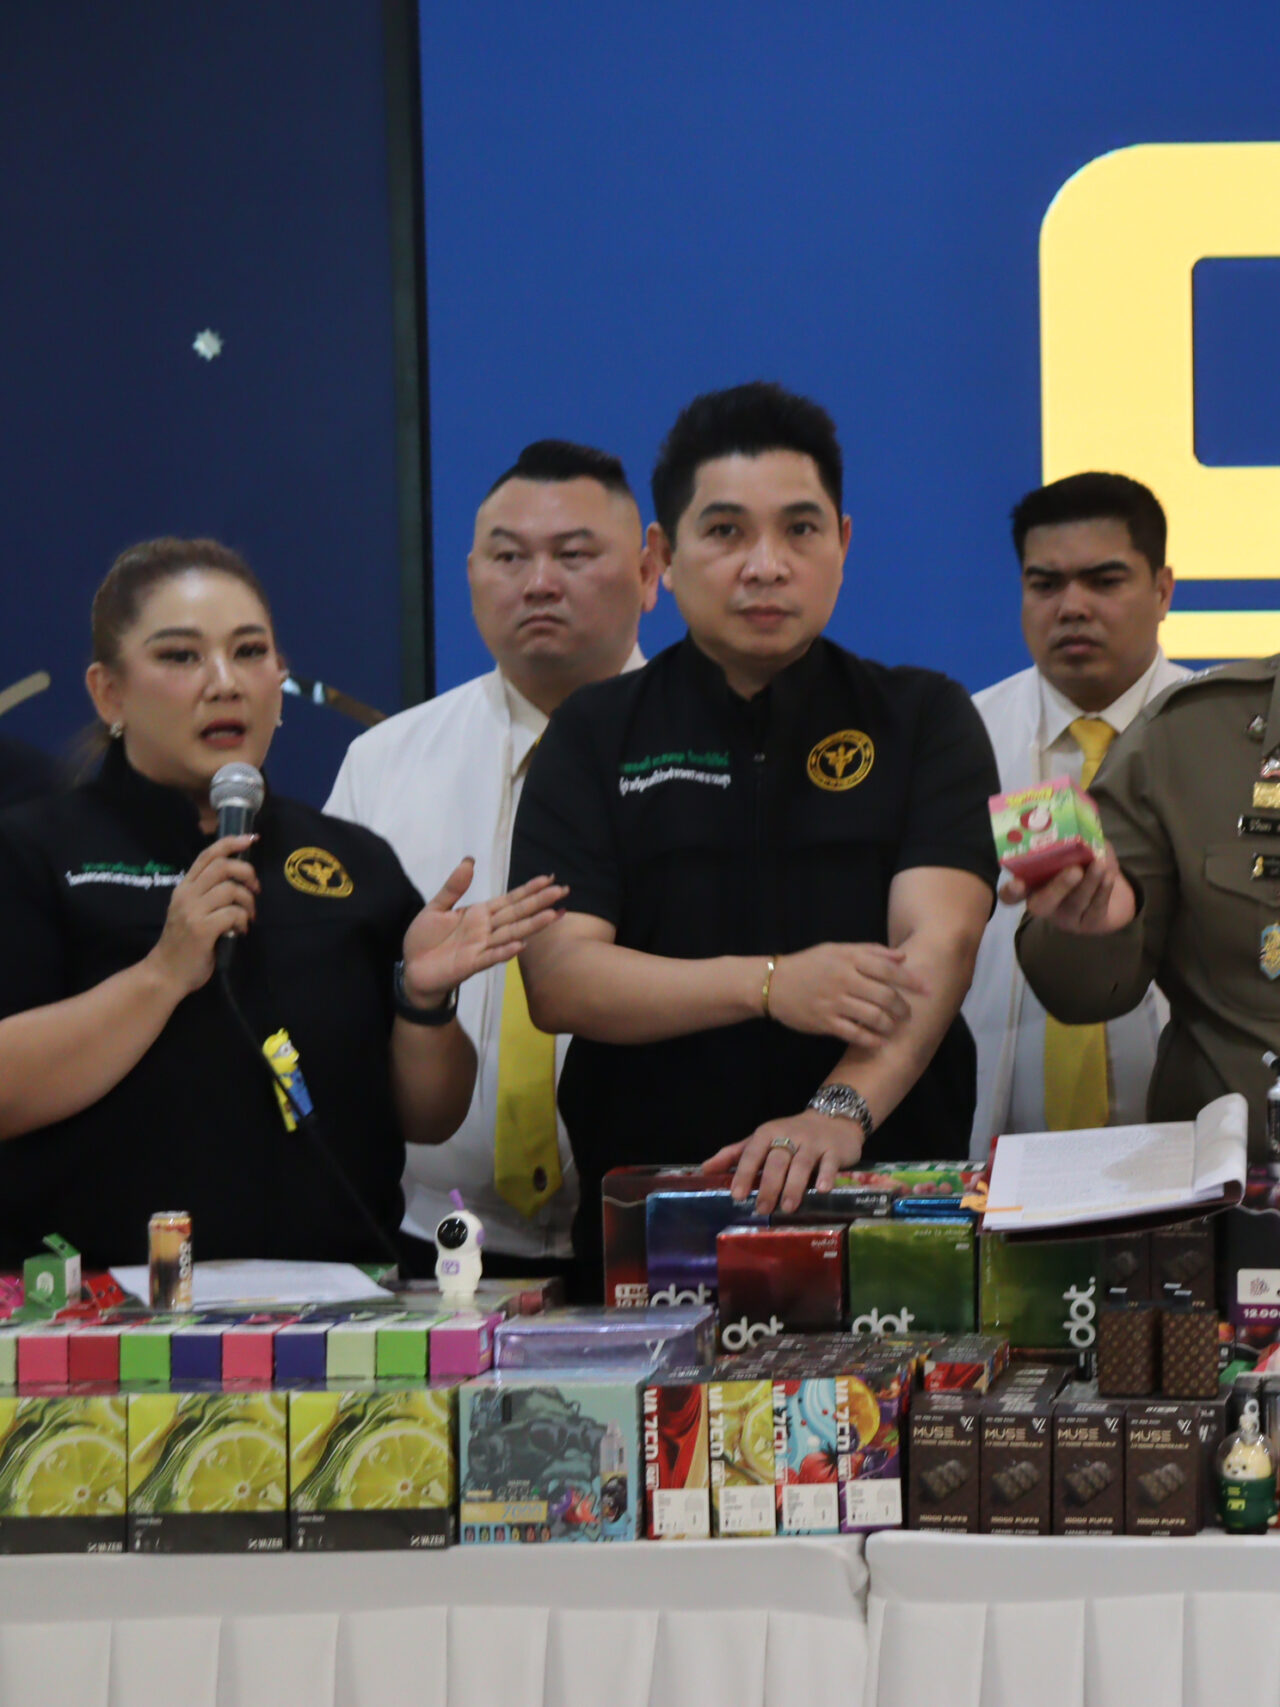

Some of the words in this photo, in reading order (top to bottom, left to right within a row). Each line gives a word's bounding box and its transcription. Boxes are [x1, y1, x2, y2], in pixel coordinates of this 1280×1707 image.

[651, 1282, 712, 1307] dot
[852, 1306, 916, 1336] dot
[913, 1426, 955, 1439] MUSE
[984, 1428, 1026, 1441] MUSE
[1057, 1428, 1099, 1441] MUSE
[1129, 1430, 1171, 1443] MUSE
